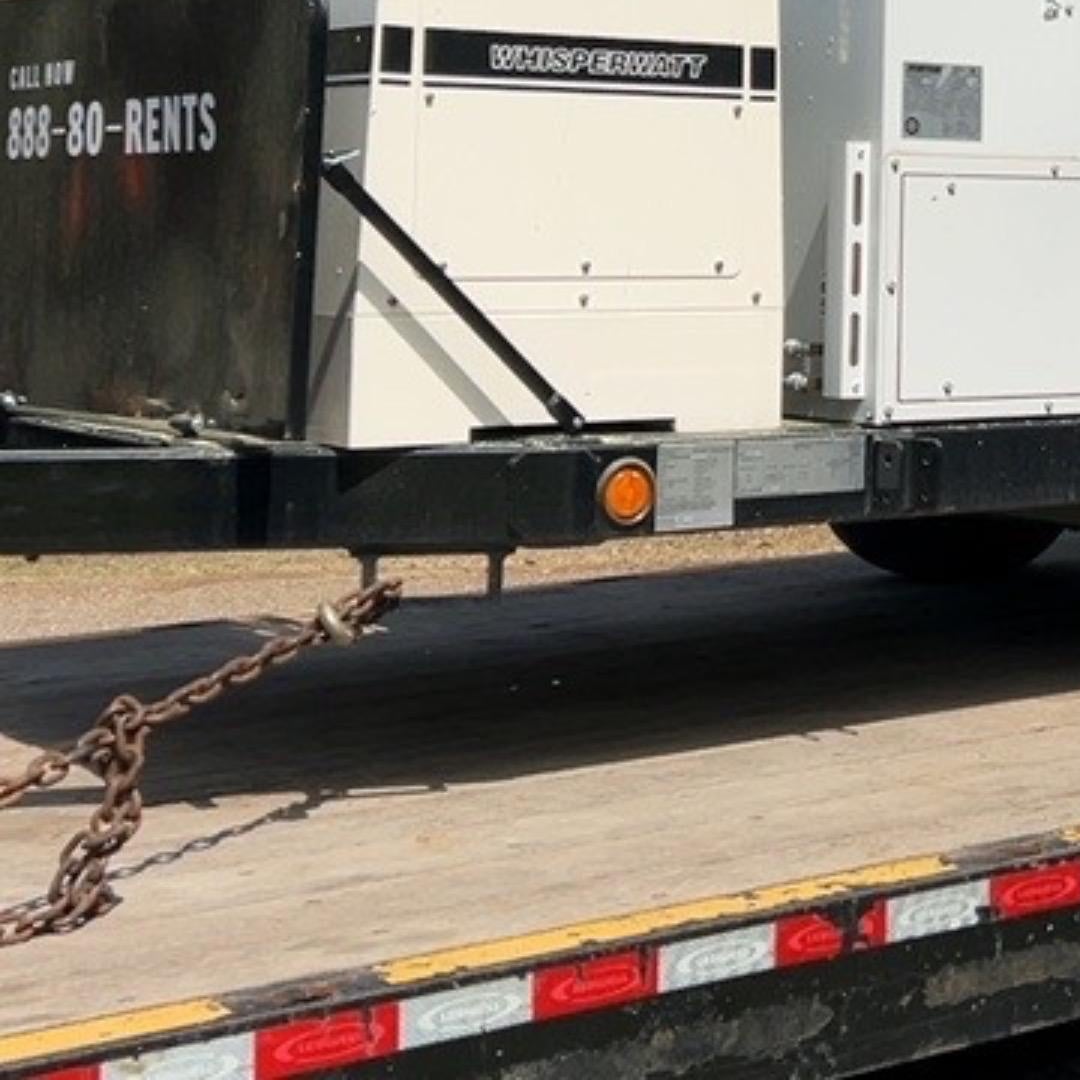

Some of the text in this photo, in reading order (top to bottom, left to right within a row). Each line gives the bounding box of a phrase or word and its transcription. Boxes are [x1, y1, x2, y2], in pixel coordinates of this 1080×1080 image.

[9, 59, 76, 91] CALL NOW
[488, 42, 708, 80] WHISPERWATT
[6, 91, 217, 160] 888-80-RENTS
